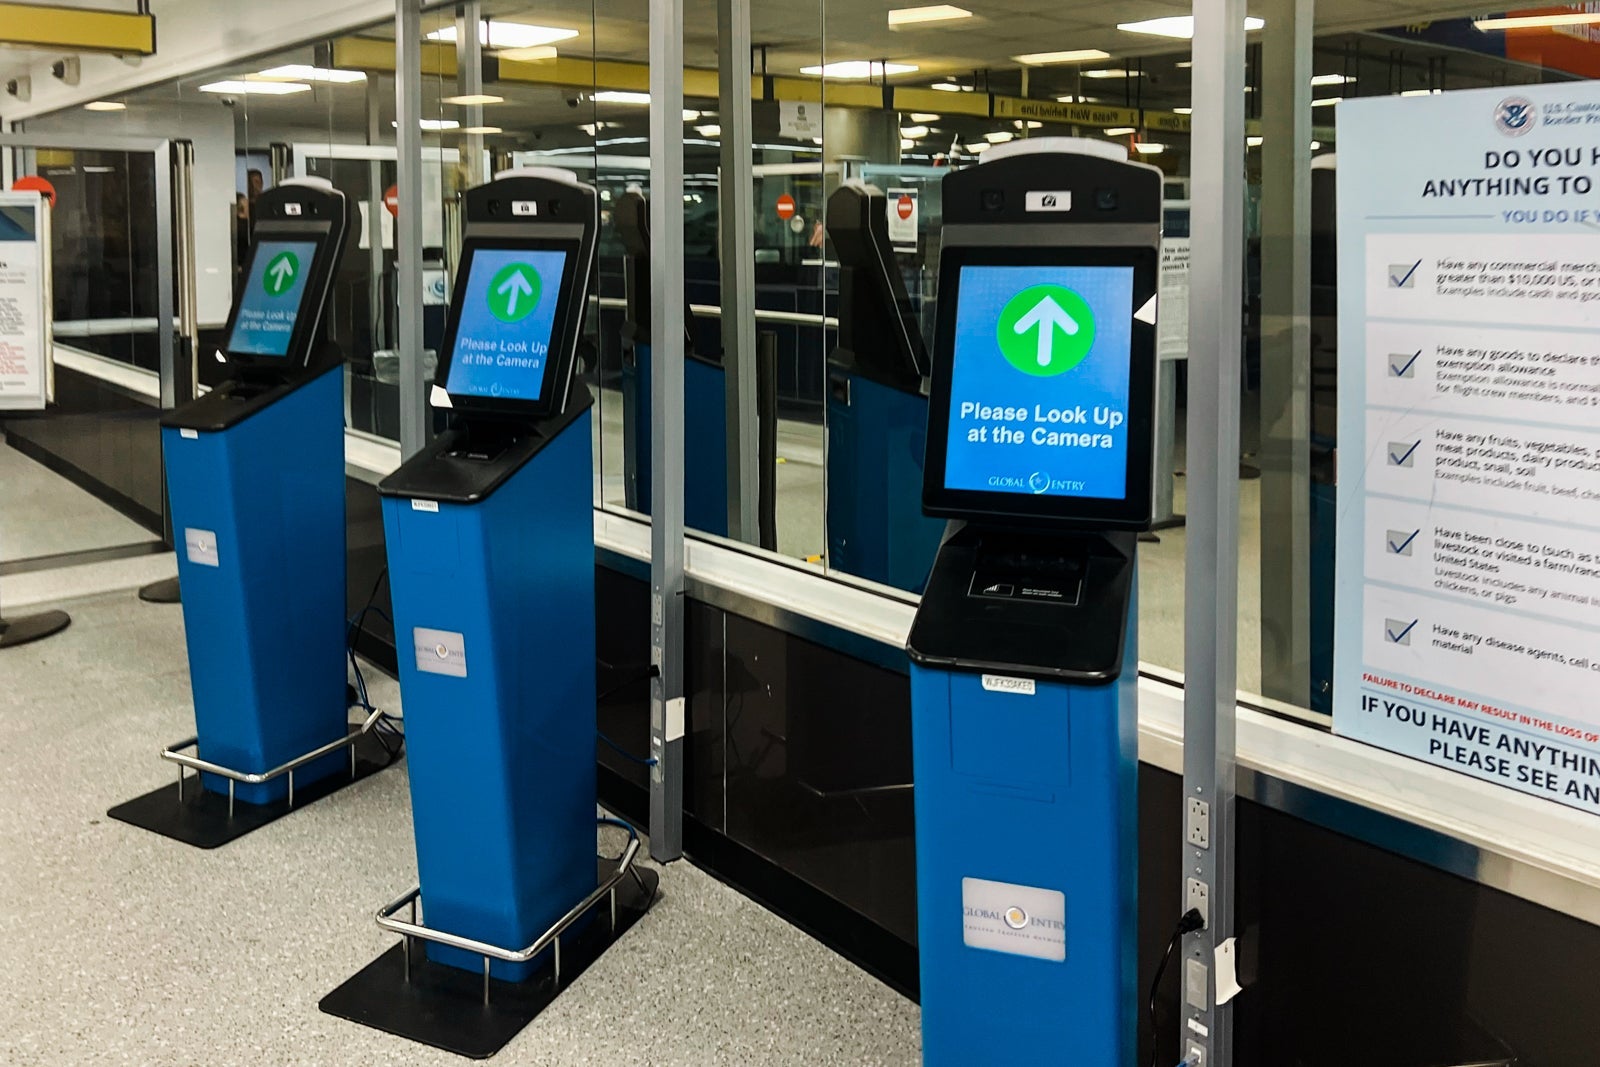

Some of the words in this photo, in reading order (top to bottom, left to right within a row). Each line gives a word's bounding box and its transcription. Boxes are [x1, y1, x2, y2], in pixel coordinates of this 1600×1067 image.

[1485, 151, 1520, 168] DO
[1528, 148, 1582, 168] YOU
[1422, 176, 1549, 198] ANYTHING
[1558, 176, 1592, 195] TO
[1503, 210, 1538, 223] YOU
[1543, 210, 1568, 222] DO
[1574, 210, 1590, 222] IF
[1436, 258, 1464, 270] Have
[1467, 261, 1488, 272] any
[1489, 260, 1558, 272] commercial
[1436, 274, 1476, 284] greater
[1478, 274, 1505, 284] than
[1508, 274, 1556, 286] $10,000
[460, 337, 498, 350] Please
[500, 338, 528, 354] Look
[532, 340, 548, 357] Up
[1437, 345, 1464, 356] Have
[1466, 349, 1487, 360] any
[1489, 350, 1524, 362] goods
[1528, 352, 1540, 362] to
[1542, 352, 1588, 364] declare
[462, 353, 474, 364] at
[476, 353, 494, 366] the
[496, 354, 540, 369] Camera
[1436, 360, 1495, 372] exemption
[1498, 363, 1556, 376] allowance
[960, 402, 1028, 422] Please
[1034, 404, 1087, 425] Look
[1093, 406, 1124, 429] Up
[968, 426, 987, 443] at
[992, 426, 1024, 444] the
[1031, 427, 1112, 448] Camera
[1436, 429, 1463, 442] Have
[1466, 434, 1486, 446] any
[1488, 434, 1522, 449] fruits,
[1436, 443, 1462, 454] meat
[1466, 447, 1519, 462] products,
[1522, 452, 1552, 468] dairy
[1484, 462, 1512, 475] snail,
[1516, 466, 1536, 477] soil
[988, 476, 1024, 488] GLOBAL
[1052, 480, 1086, 492] ENTRY
[1434, 526, 1462, 540] Have
[1464, 531, 1492, 546] been
[1495, 537, 1524, 551] close
[1527, 543, 1540, 554] to
[1542, 544, 1574, 560] (such
[1578, 553, 1592, 562] as
[1434, 539, 1480, 555] livestock
[1482, 548, 1494, 558] or
[1496, 551, 1532, 566] visited
[1534, 558, 1542, 568] a
[1434, 552, 1466, 566] United
[1468, 558, 1500, 574] States
[1434, 578, 1479, 596] chickens,
[1481, 589, 1493, 598] or
[1496, 592, 1517, 604] pigs
[1435, 566, 1480, 582] Livestock
[1482, 576, 1526, 592] includes
[1528, 586, 1549, 598] any
[1550, 589, 1589, 604] animal
[1432, 623, 1460, 638] Have
[1462, 632, 1482, 646] any
[1486, 636, 1524, 654] disease
[1526, 647, 1566, 664] agents,
[1568, 656, 1589, 670] cell
[1432, 638, 1474, 656] material
[1362, 672, 1398, 690] FAILURE
[1399, 682, 1412, 694] TO
[1414, 686, 1456, 706] DECLARE
[1458, 698, 1480, 711] MAY
[1481, 704, 1518, 722] RESULT
[1519, 715, 1530, 726] IN
[1530, 718, 1552, 732] THE
[1554, 724, 1582, 739] LOSS
[1584, 732, 1600, 744] OF
[1362, 695, 1379, 712] IF
[1383, 700, 1426, 727] YOU
[1432, 714, 1490, 746] HAVE
[1430, 738, 1510, 778] PLEASE
[1517, 764, 1558, 792] SEE
